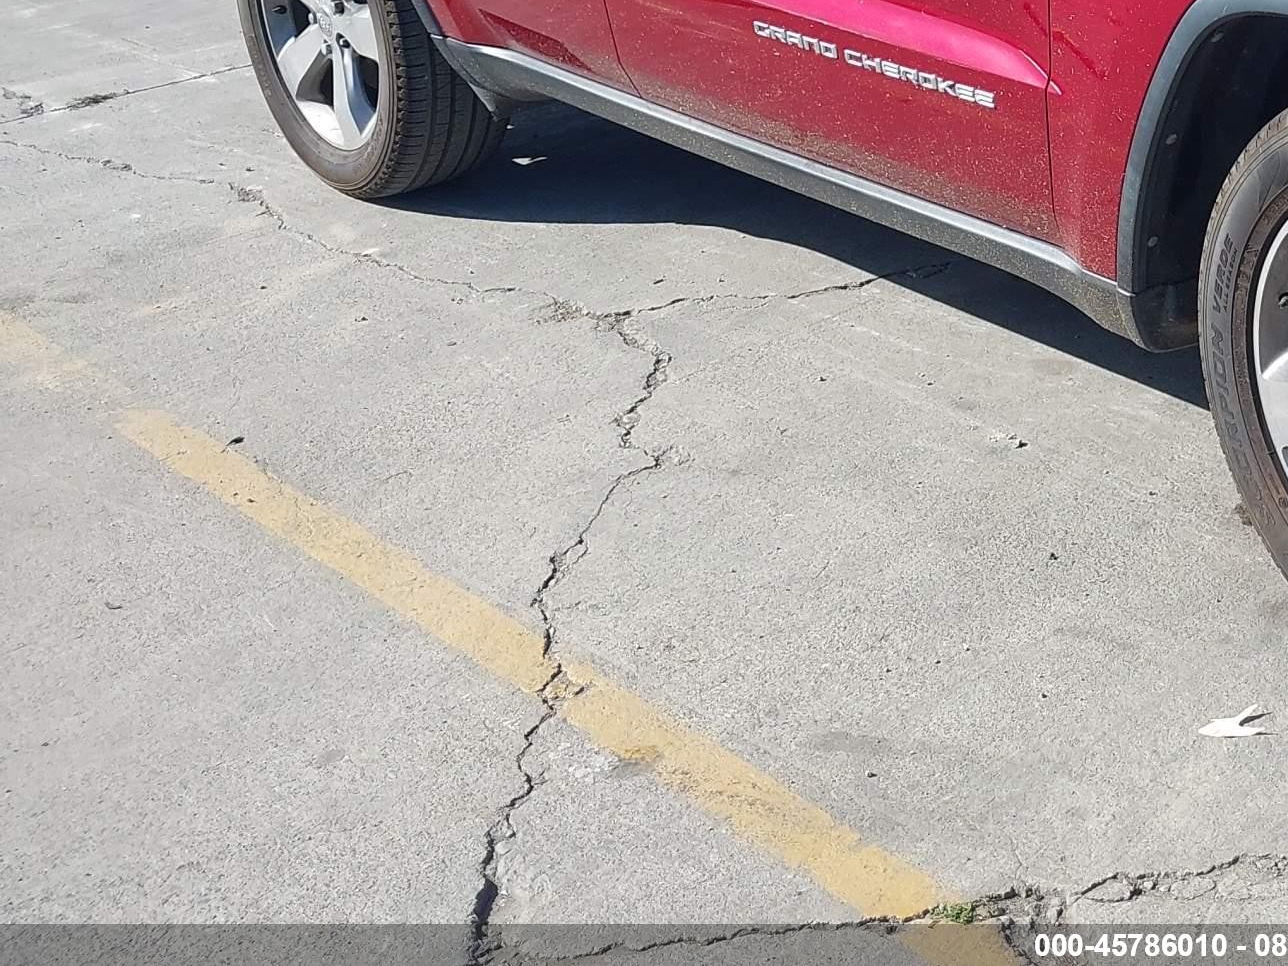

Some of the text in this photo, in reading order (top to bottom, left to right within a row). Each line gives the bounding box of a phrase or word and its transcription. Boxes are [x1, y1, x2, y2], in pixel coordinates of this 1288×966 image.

[752, 20, 997, 109] GRAND CHEROKEE
[1212, 232, 1235, 315] VERDE
